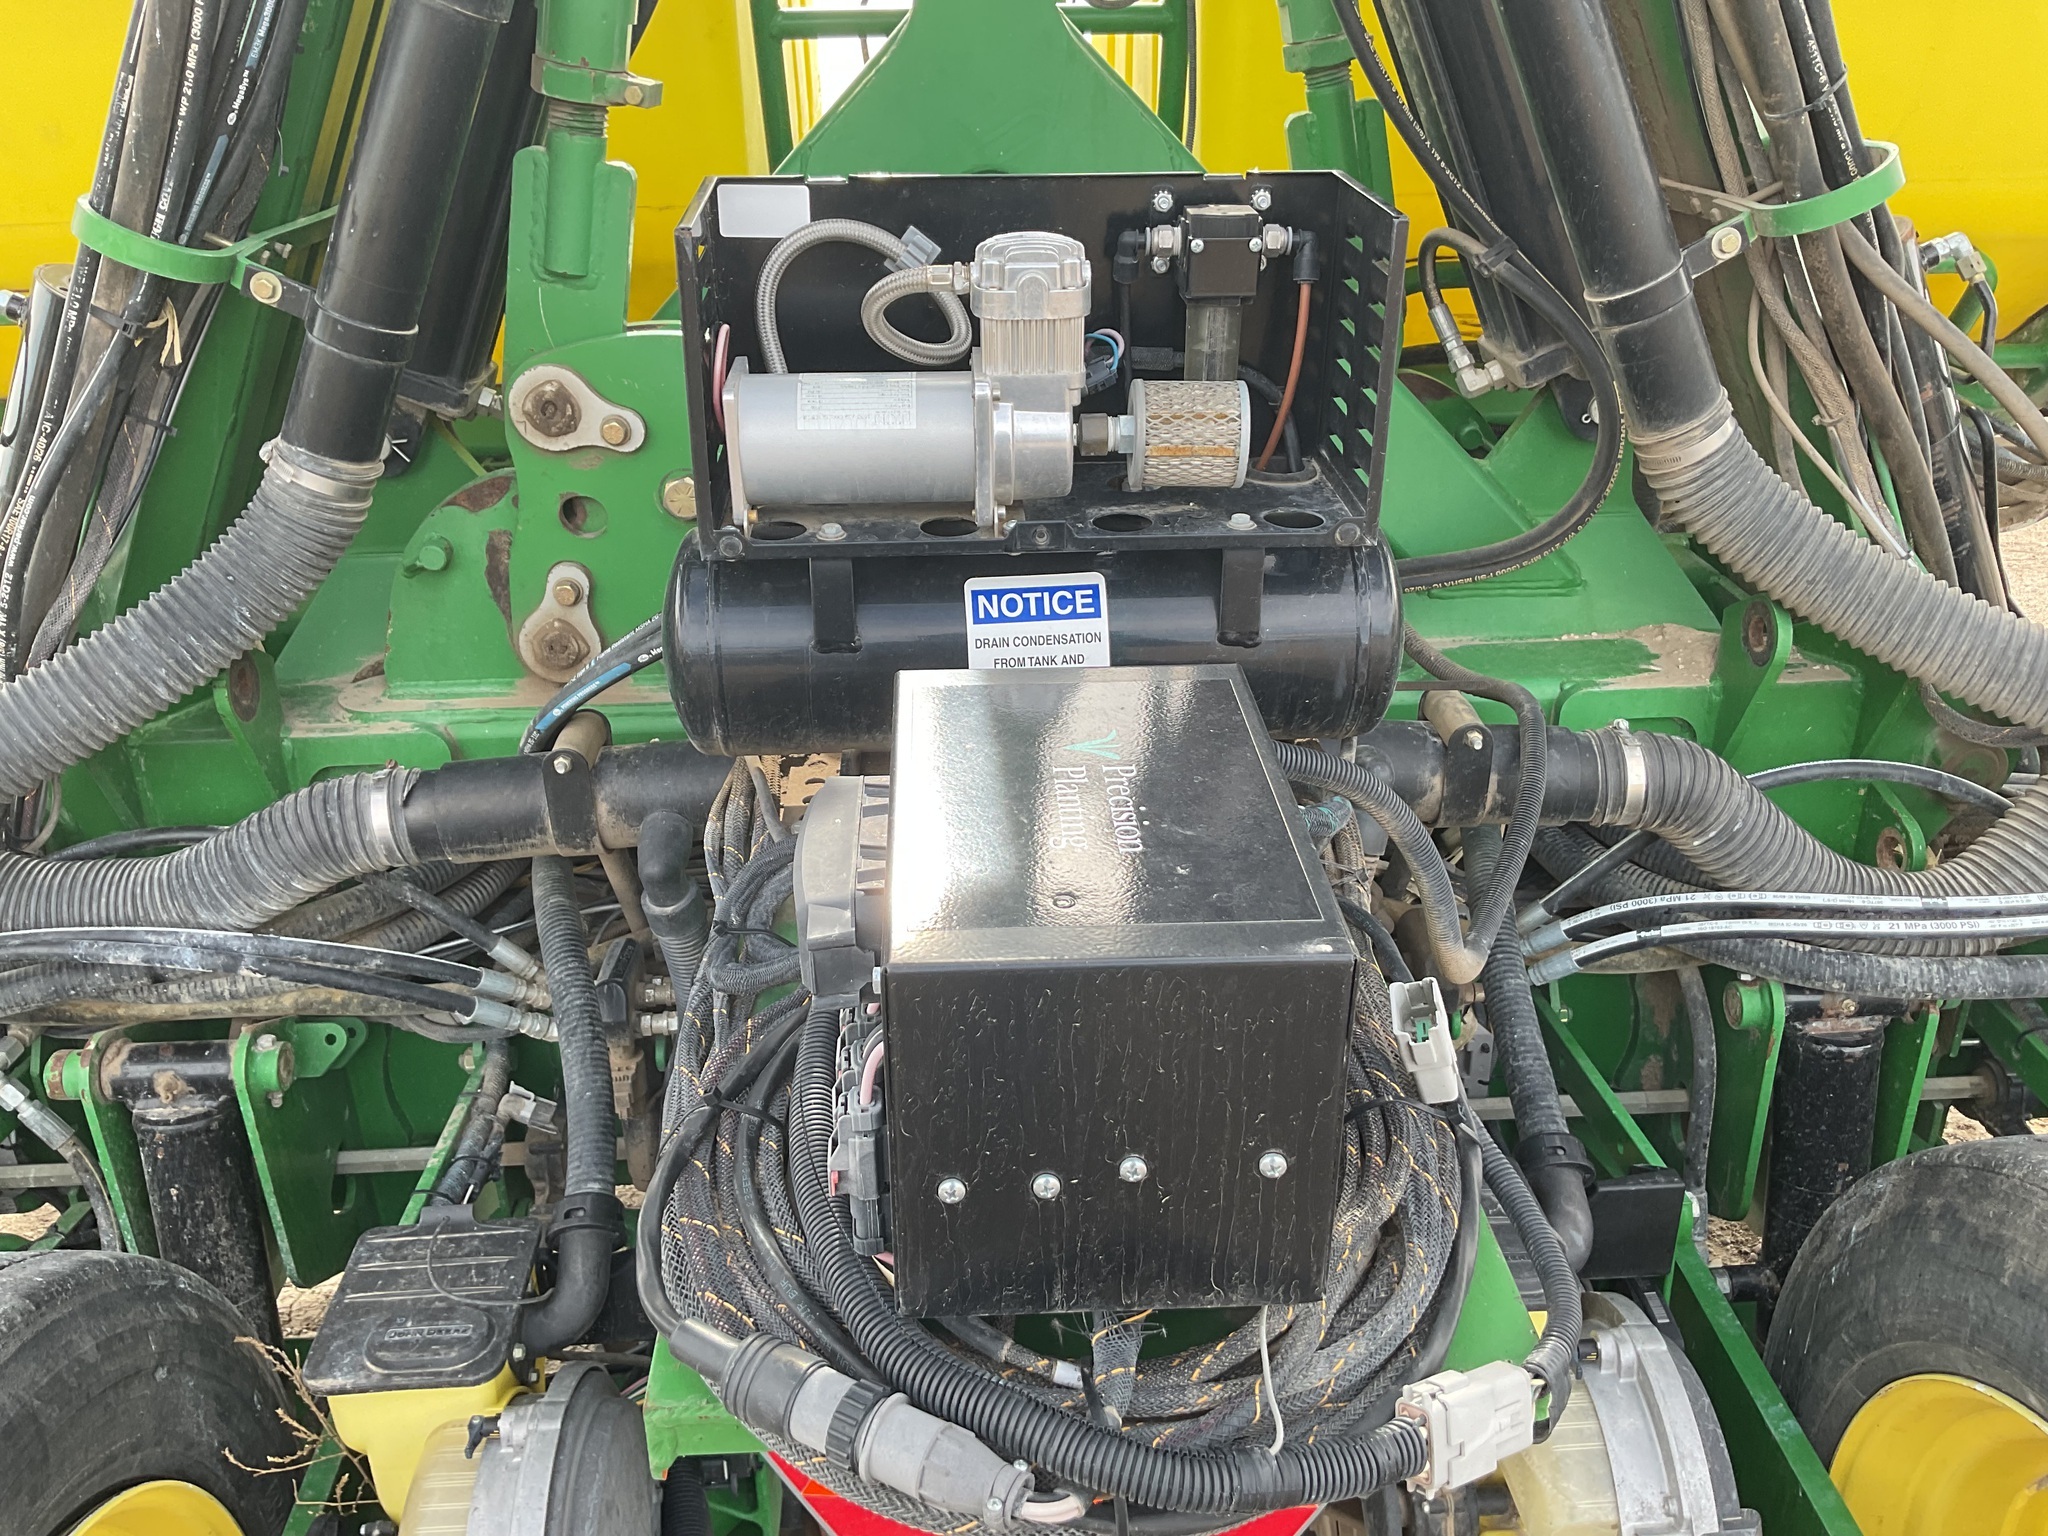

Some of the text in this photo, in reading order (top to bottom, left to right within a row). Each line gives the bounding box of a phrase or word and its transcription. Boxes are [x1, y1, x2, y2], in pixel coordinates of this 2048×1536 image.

[190, 7, 204, 41] (3000
[186, 42, 200, 70] MPa
[178, 96, 190, 116] WP
[32, 420, 53, 462] IC-40/26
[12, 497, 26, 517] SAE
[8, 494, 36, 568] www.parker.com
[977, 589, 1095, 619] NOTICE
[975, 632, 1102, 650] DRAIN CONDENSATION
[993, 653, 1085, 669] FROM TANK AND
[1050, 764, 1090, 850] Planting
[1101, 764, 1151, 853] Precision
[1609, 900, 1630, 912] PSI)
[1632, 896, 1659, 908] (3000
[1660, 894, 1682, 905] MPa
[1683, 893, 1697, 902] 21
[1888, 922, 1900, 930] 21
[1904, 921, 1928, 930] MPa
[1930, 921, 1958, 930] (3000
[1960, 920, 1980, 930] PSI)
